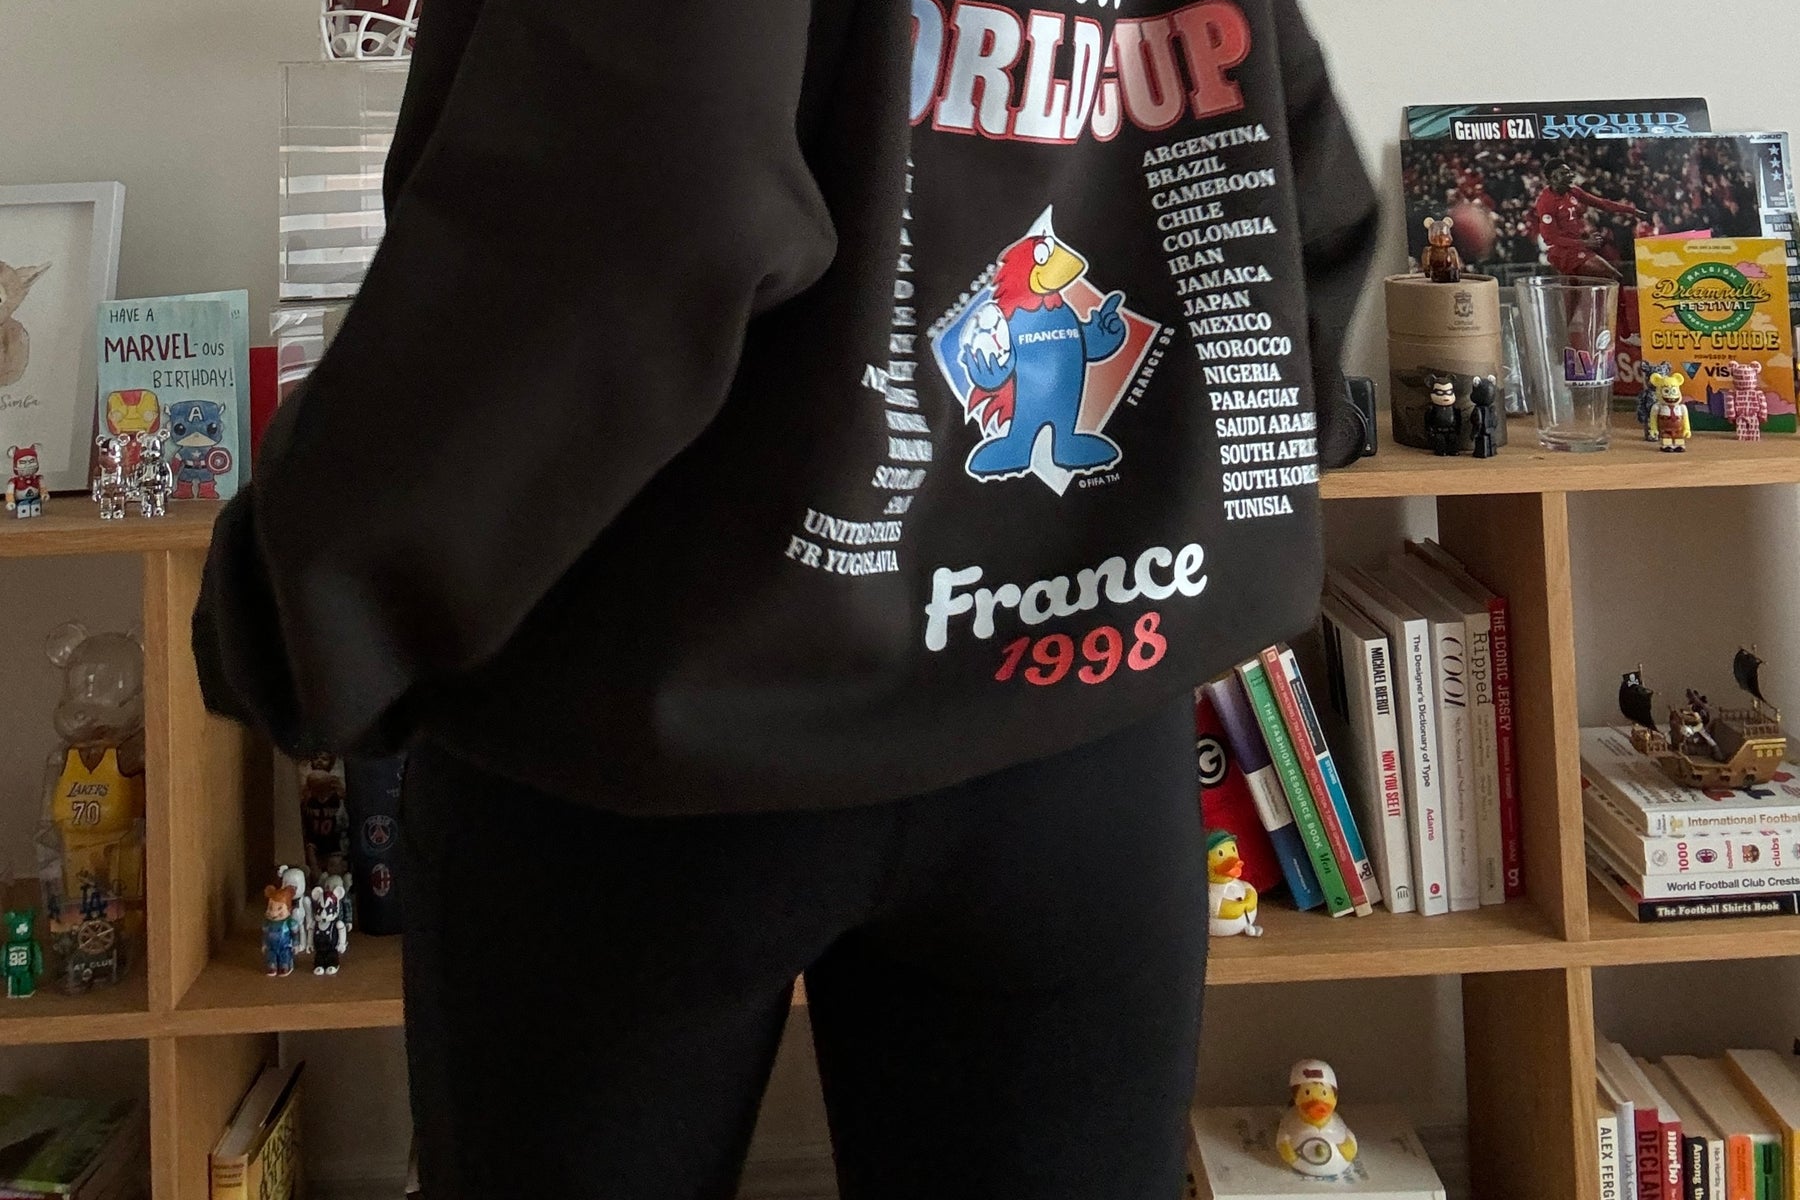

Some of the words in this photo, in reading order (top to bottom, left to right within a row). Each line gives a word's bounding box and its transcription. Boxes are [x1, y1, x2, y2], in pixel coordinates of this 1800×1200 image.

[1455, 116, 1535, 140] GENIUS/GZA
[1543, 112, 1688, 128] LIQUID
[1142, 123, 1271, 168] ARGENTINA
[1145, 155, 1228, 189] BRAZIL
[1152, 168, 1277, 210] CAMEROON
[1157, 201, 1225, 231] CHILE
[1163, 216, 1278, 252] COLOMBIA
[1168, 247, 1225, 275] IRAN
[1686, 266, 1738, 282] RALEIGH
[1177, 264, 1273, 296] JAMAICA
[110, 308, 140, 323] HAVE
[146, 308, 154, 322] A
[1184, 290, 1251, 317] JAPAN
[1679, 300, 1750, 312] FESTIVAL
[1018, 331, 1065, 345] FRANCE
[1188, 312, 1273, 338] MEXICO
[1195, 336, 1292, 361] MOROCCO
[1652, 330, 1703, 349] CITY
[1711, 330, 1780, 350] GUIDE
[153, 367, 235, 390] BIRTHDAY!
[1126, 349, 1164, 407] FRANCE
[1203, 363, 1281, 385] NIGERIA
[1209, 387, 1300, 411] PARAGUAY
[1215, 415, 1266, 438] SAUDI
[1268, 411, 1318, 435] ARAB
[1220, 442, 1275, 465] SOUTH
[1277, 437, 1319, 460] AFRI
[1222, 468, 1278, 493] SOUTH
[1279, 464, 1320, 487] KOR
[1224, 494, 1293, 521] TUNISIA
[785, 534, 823, 569] FR
[924, 543, 1208, 652] France
[994, 611, 1168, 686] 1998
[1413, 634, 1421, 653] The
[1371, 646, 1386, 686] MICHAEL
[1413, 654, 1425, 702] Designer's
[1472, 632, 1491, 706] Ripped
[1374, 685, 1390, 716] BIERUT
[1497, 684, 1512, 731] JERSEY
[1416, 703, 1430, 749] Dictionary
[1381, 749, 1396, 772] NOW
[1421, 749, 1430, 763] of
[1262, 702, 1276, 723] THE
[1271, 724, 1293, 768] FASHION
[1287, 768, 1313, 821] RESOURCE
[1307, 822, 1324, 850] BOOK
[1383, 772, 1398, 791] YOU
[1421, 764, 1432, 788] Type
[66, 782, 110, 798] LAKERS
[1386, 791, 1400, 808] SEE
[72, 800, 101, 826] 70
[1387, 807, 1401, 818] IT
[1425, 807, 1436, 841] Adams
[1688, 814, 1757, 828] International
[1677, 842, 1689, 872] 1000
[1772, 837, 1782, 867] clubs
[1667, 881, 1697, 892] World
[1700, 879, 1740, 890] Football
[1742, 878, 1766, 888] Club
[1768, 876, 1800, 886] Crests
[1656, 907, 1677, 917] The
[1679, 904, 1720, 915] Football
[1722, 902, 1752, 913] Shirts
[1754, 901, 1780, 911] Book
[1600, 1127, 1614, 1160] ALEX
[1667, 1131, 1682, 1184] morbo
[1692, 1143, 1704, 1185] Among
[1602, 1165, 1616, 1200] FERG
